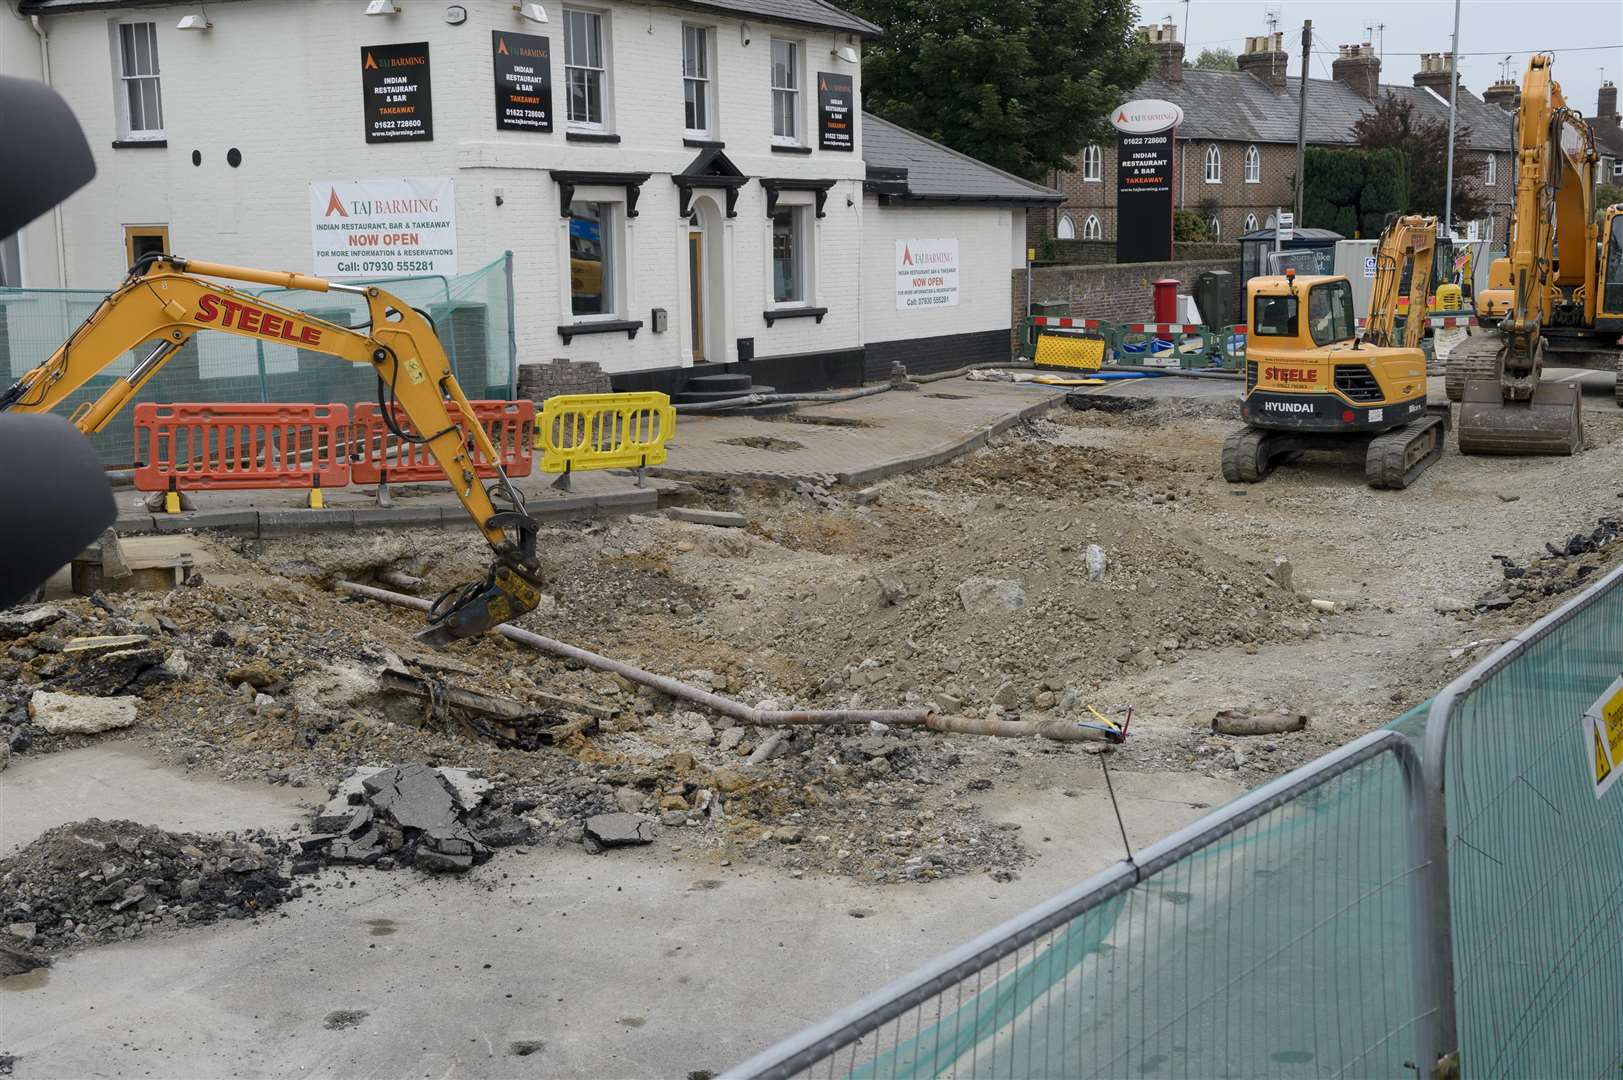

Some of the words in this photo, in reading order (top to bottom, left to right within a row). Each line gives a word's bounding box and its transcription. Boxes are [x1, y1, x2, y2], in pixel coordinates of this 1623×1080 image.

[391, 56, 424, 67] BARMING
[506, 74, 542, 83] RESTAURANT
[374, 85, 418, 94] RESTAURANT
[510, 96, 540, 104] TAKEAWAY
[380, 106, 415, 114] TAKEAWAY
[506, 108, 524, 116] 01622
[504, 118, 548, 126] www.tajbarming.com
[352, 200, 372, 216] TAJ
[376, 198, 439, 214] BARMING
[349, 234, 379, 246] NOW
[383, 233, 418, 246] OPEN
[337, 262, 360, 272] Call:
[363, 262, 393, 271] 07930
[397, 261, 434, 271] 555281
[913, 278, 926, 287] NOW
[928, 277, 943, 286] OPEN
[194, 293, 322, 346] STEELE
[1265, 368, 1317, 382] STEELE
[1265, 402, 1314, 413] HYUNDAI
